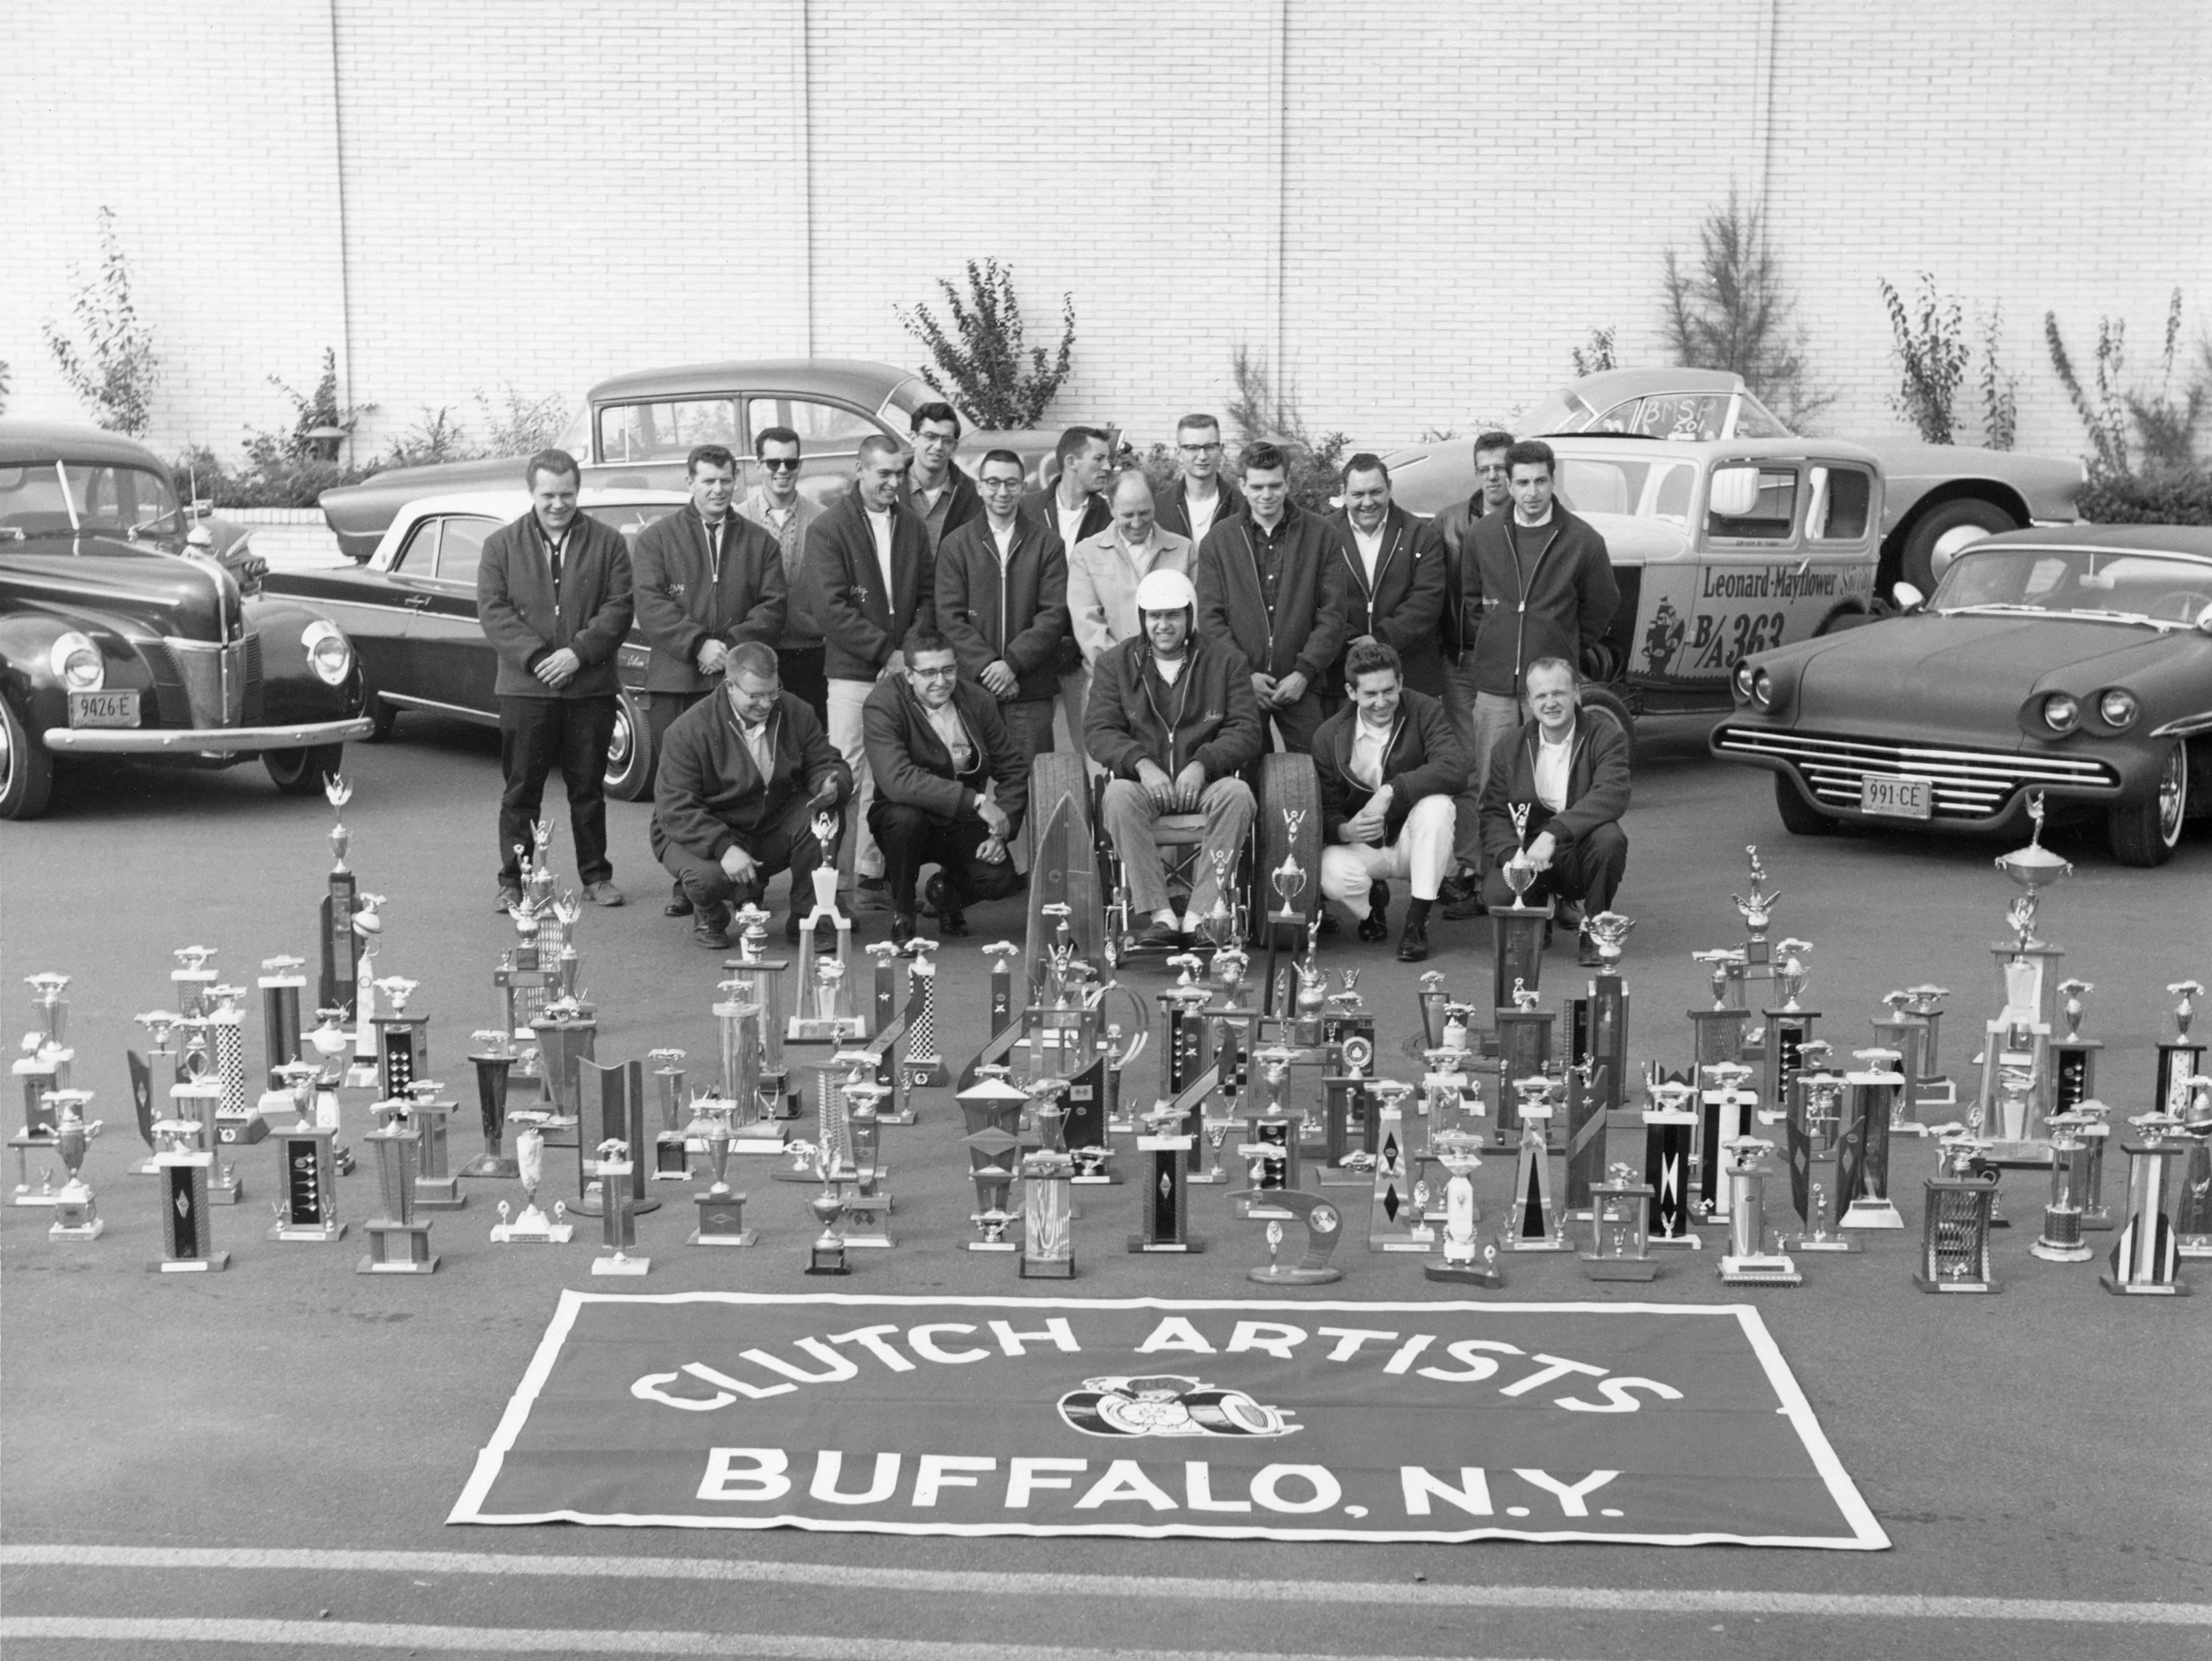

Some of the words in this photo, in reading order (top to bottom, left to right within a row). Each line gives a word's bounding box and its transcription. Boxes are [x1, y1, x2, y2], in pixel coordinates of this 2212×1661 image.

[630, 1317, 1081, 1410] CLUTCH
[1134, 1317, 1685, 1413] ARTISTS
[1400, 1466, 1625, 1517] N.Y.
